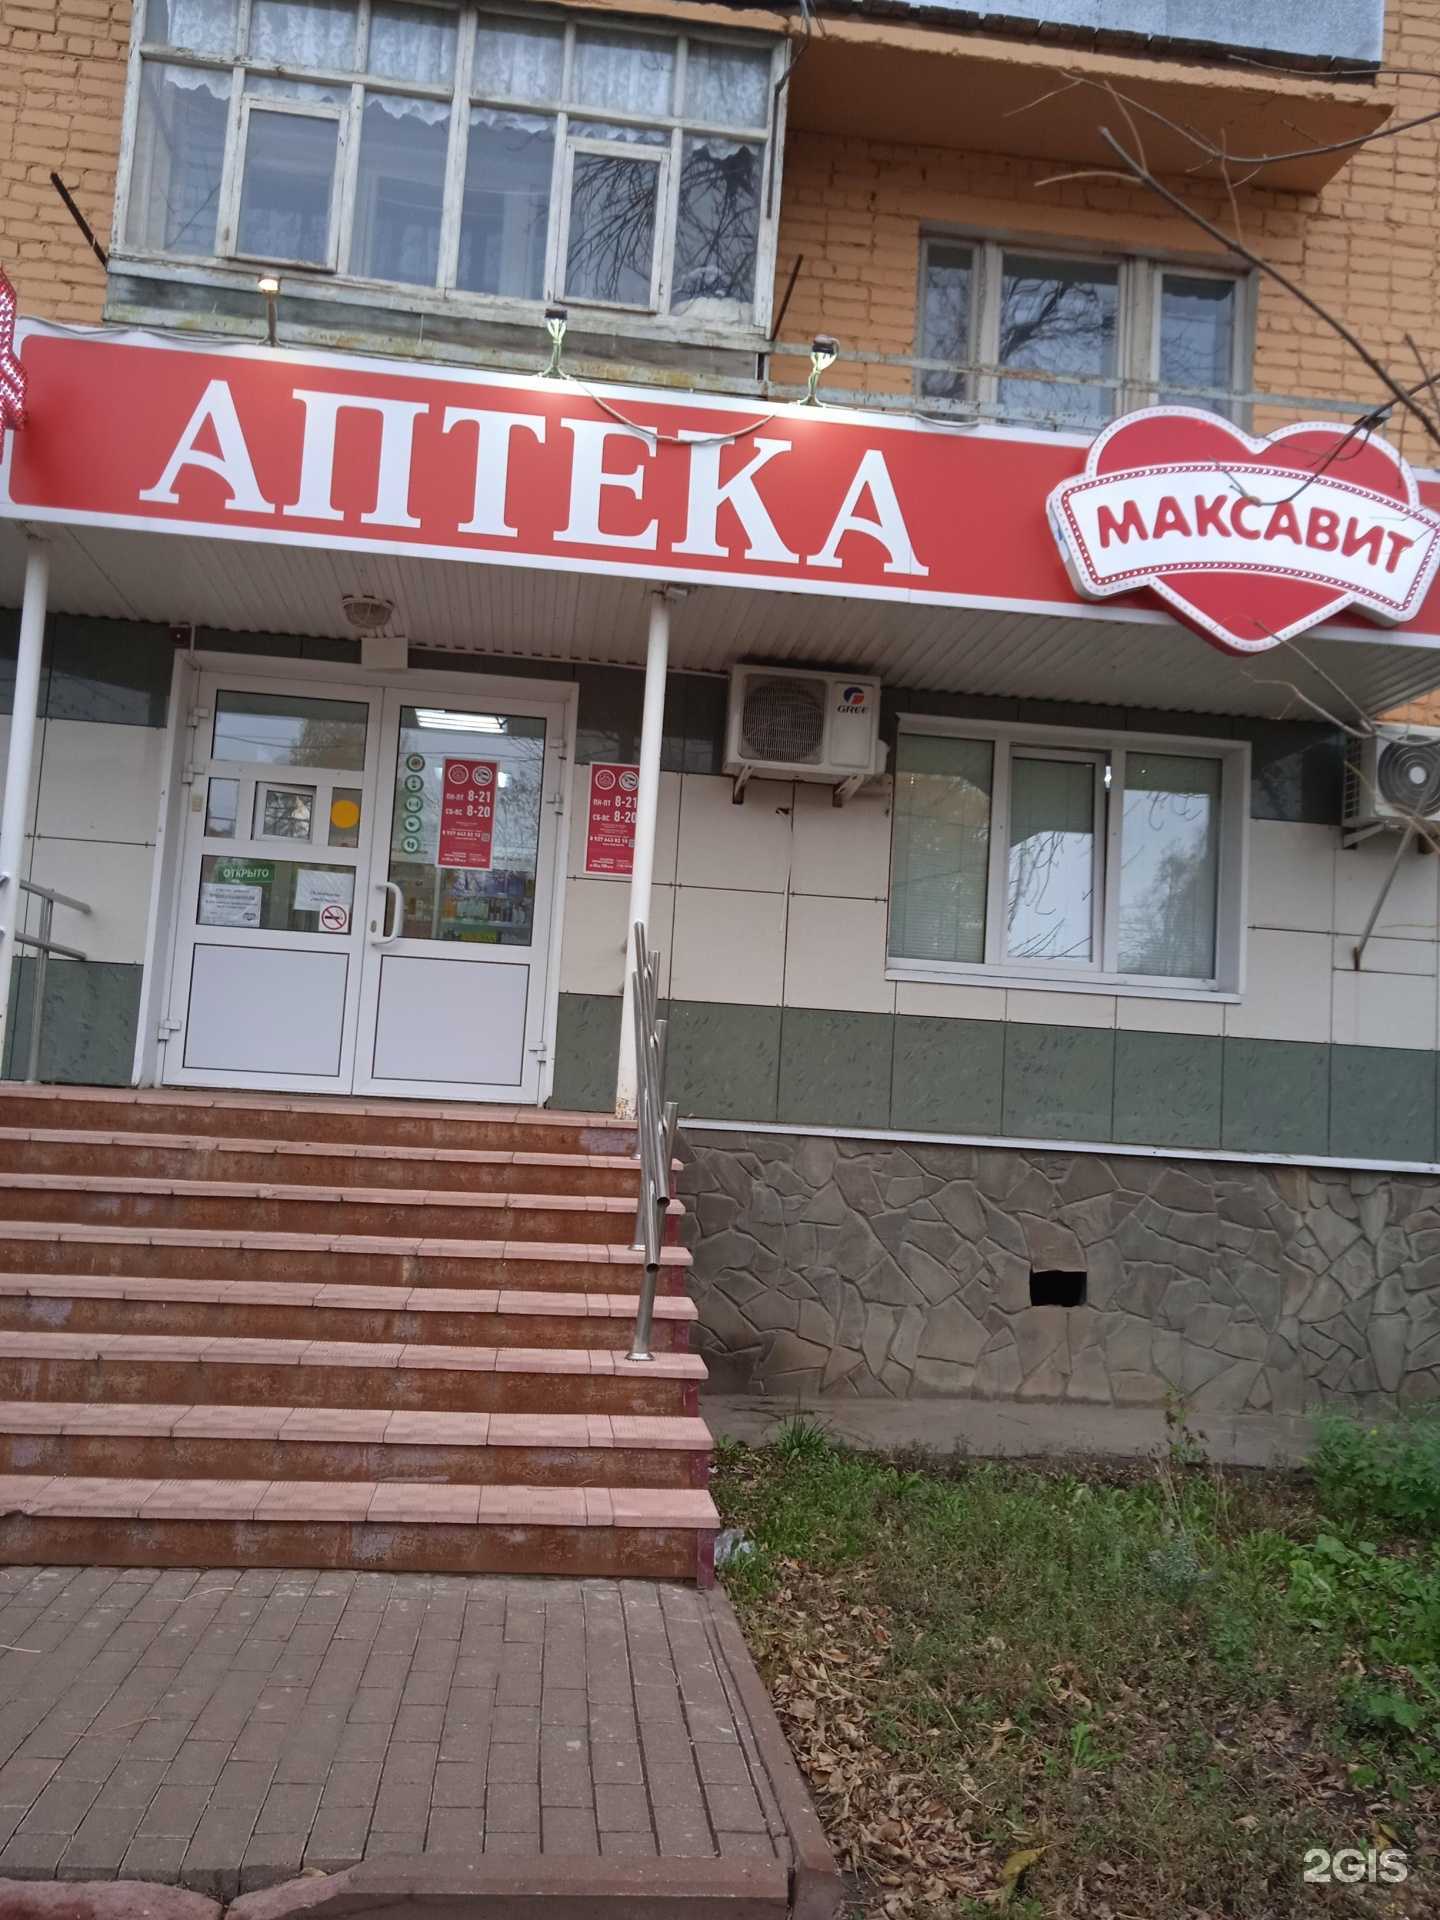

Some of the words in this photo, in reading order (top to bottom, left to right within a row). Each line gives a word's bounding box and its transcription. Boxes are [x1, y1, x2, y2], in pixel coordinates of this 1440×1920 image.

[138, 378, 931, 577] АПТЕКА
[1097, 494, 1415, 574] МАКСАВИТ
[837, 704, 868, 714] GREE
[468, 790, 491, 803] 8-21
[615, 795, 637, 809] 8-21
[466, 805, 491, 817] 8-20
[223, 867, 269, 878] ОТКРЫТО
